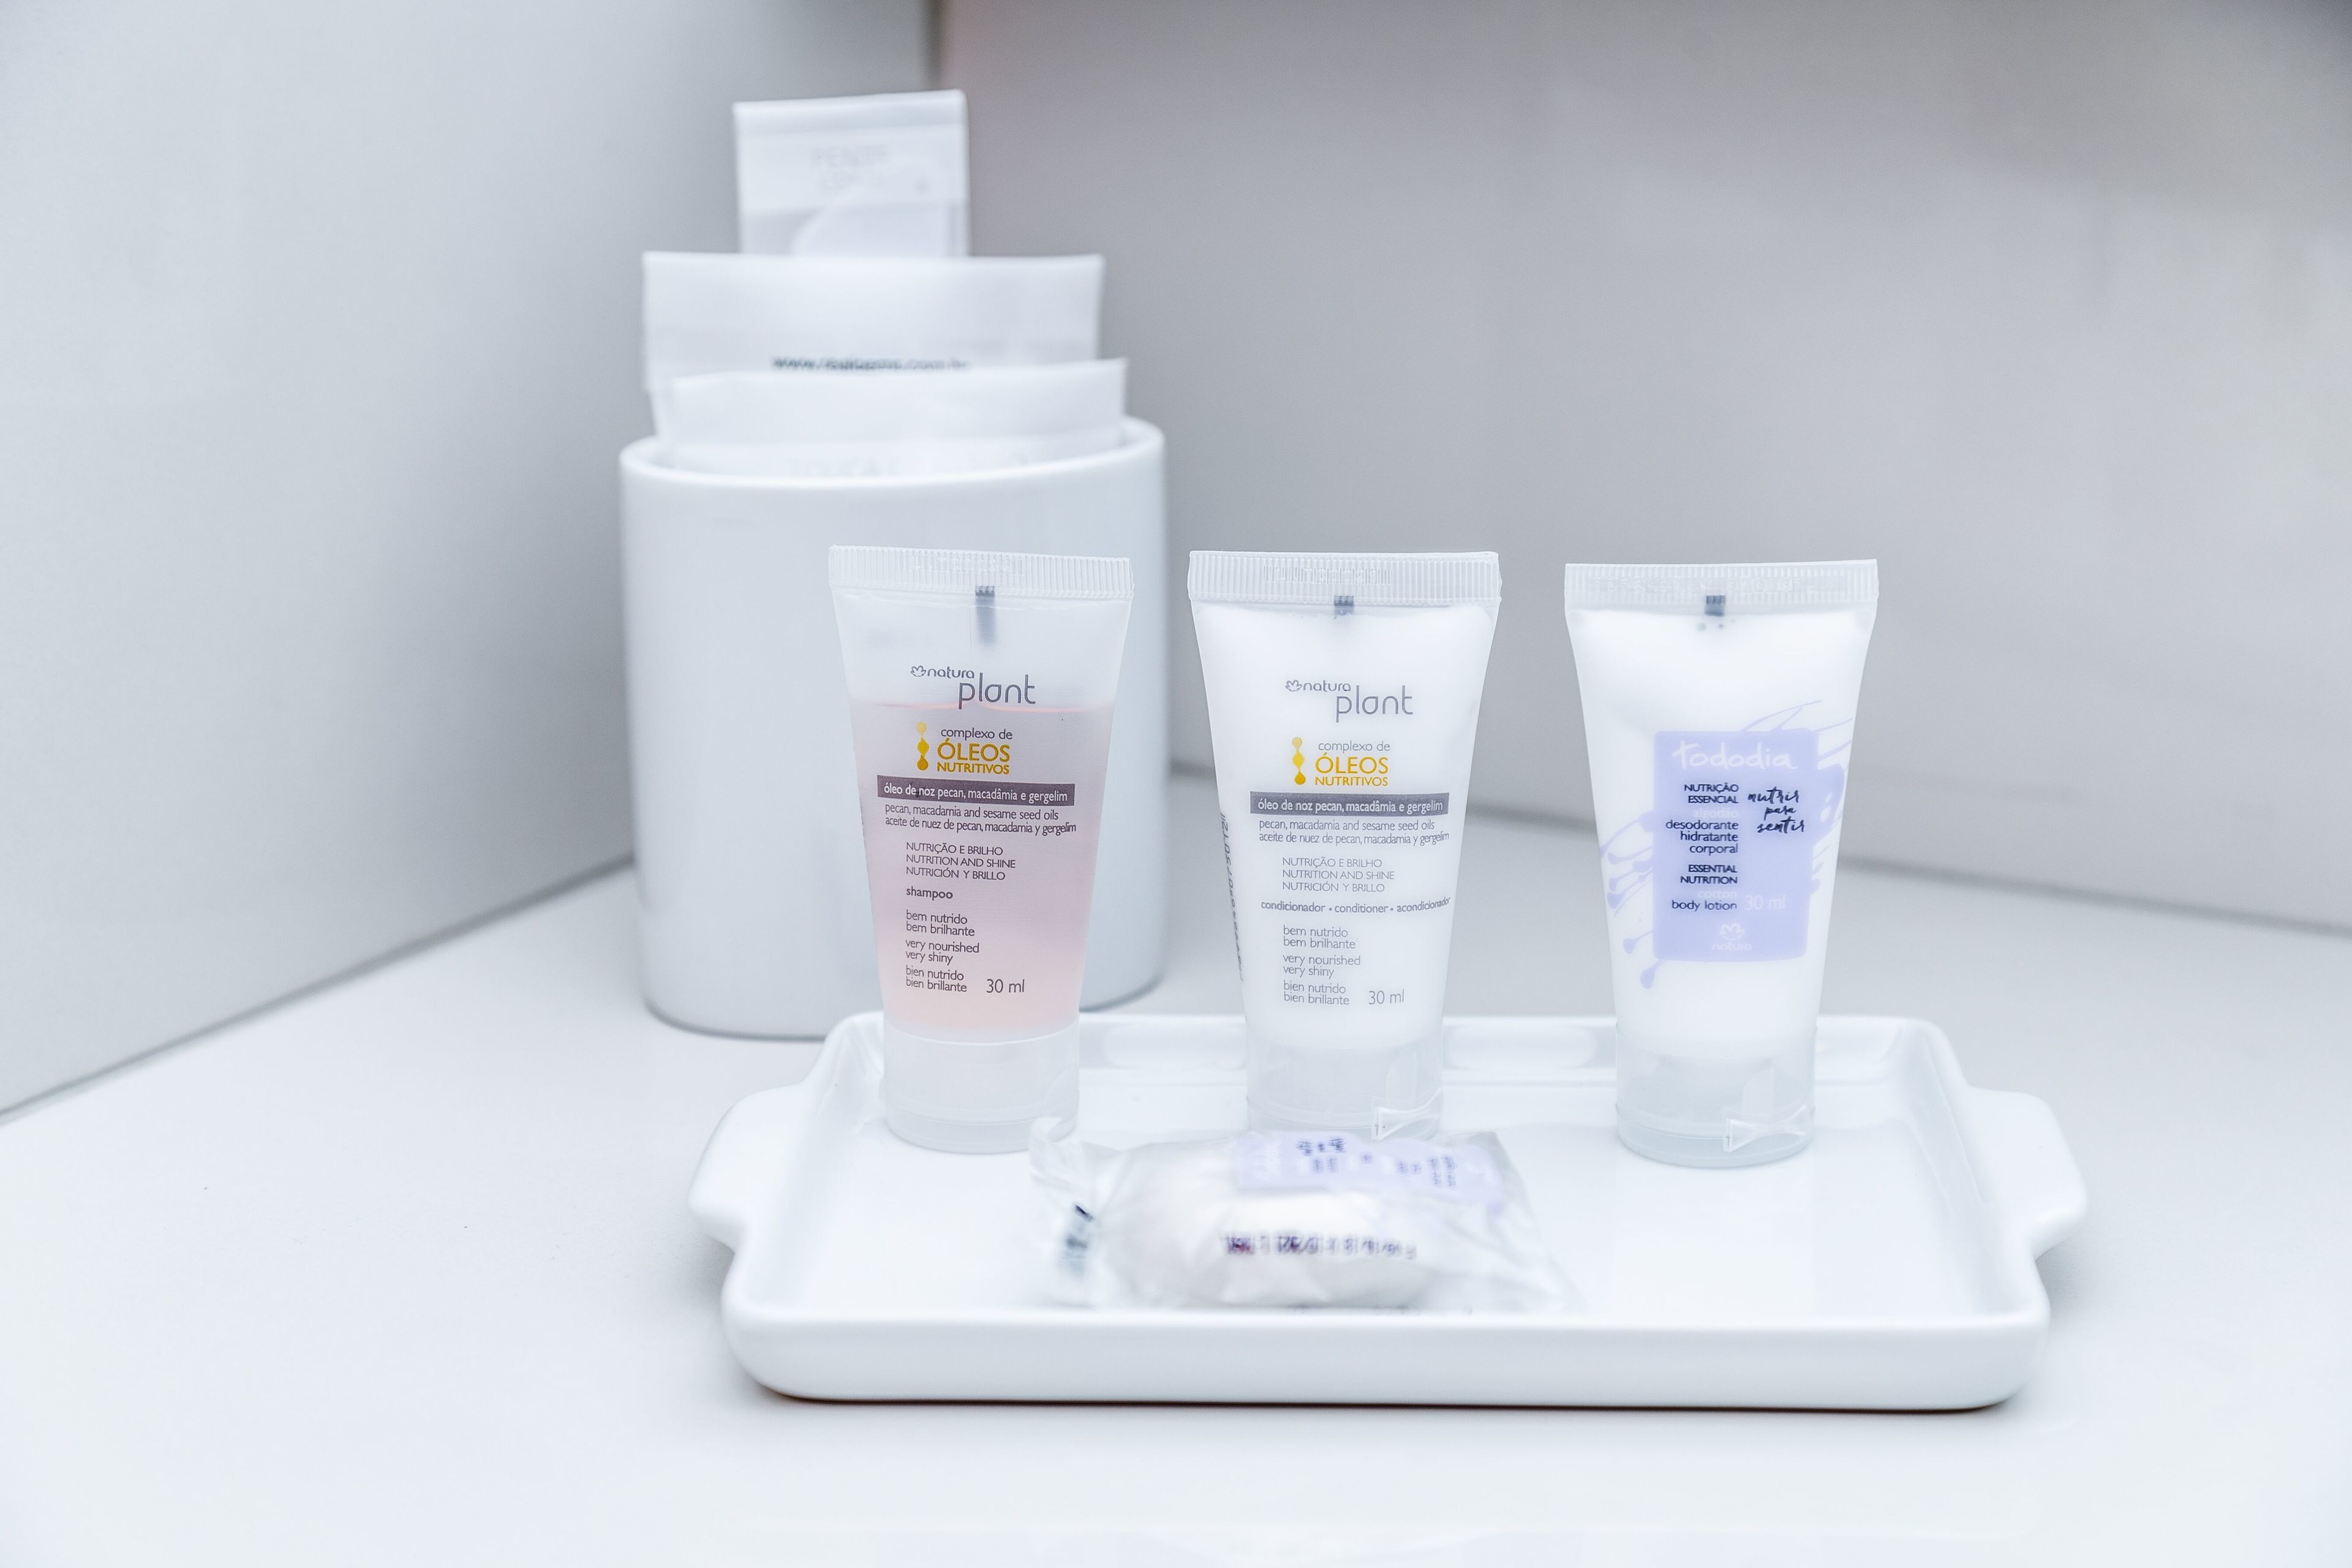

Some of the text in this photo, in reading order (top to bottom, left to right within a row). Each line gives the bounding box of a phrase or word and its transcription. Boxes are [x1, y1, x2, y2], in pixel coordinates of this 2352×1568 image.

[927, 666, 974, 679] natura
[959, 673, 1036, 709] plant
[1303, 680, 1351, 692] natura
[1336, 685, 1414, 723] plant
[941, 728, 1013, 741] complexo de
[937, 738, 1011, 763] ÓLEOS
[1318, 741, 1390, 753] complexo de
[937, 762, 1010, 775] NUTRITIVOS
[1315, 752, 1389, 774] ÓLEOS
[1315, 776, 1388, 786] NUTRITIVOS
[1684, 782, 1739, 794] NUTRIÇÃO
[884, 782, 1068, 804] óleo de noz pecan, macadâmia e gergelim
[1748, 786, 1800, 804] nutrir
[885, 804, 1058, 820] pecan, macadamia and sesame seed oils
[1258, 798, 1443, 815] óleo de noz pecan, macadâmia e gergelim
[1693, 807, 1738, 820] algodão
[1764, 805, 1796, 820] para
[885, 815, 1076, 836] aceite de nuez de pecan, macadamia y gergelim
[1259, 819, 1435, 831] pecan, macadamia and sesame seed oils
[1666, 820, 1739, 830] desodorante
[1756, 817, 1805, 834] sentir
[1259, 831, 1450, 846] aceite de nuez de pecan, macadamia y gergelim
[1680, 831, 1739, 842] hidratante
[907, 841, 1003, 856] NUTRIÇÃO E BRILHO
[1689, 843, 1738, 856] corporal
[907, 854, 1016, 869] NUTRITION AND SHINE
[1283, 856, 1382, 869] NUTRIÇÃO E BRILHO
[907, 867, 1006, 880] NUTRICIÓN Y BRILLO
[1283, 870, 1395, 880] NUTRITION AND SHINE
[906, 886, 953, 900] shampoo
[1283, 881, 1385, 892] NUTRICIÓN Y BRILLO
[1697, 889, 1738, 899] cotton
[1261, 896, 1451, 914] condicionador conditioner acondicionador
[1672, 900, 1737, 911] body lotion
[1744, 895, 1785, 910] 30 ml
[906, 909, 968, 924] bem nutrido
[906, 921, 975, 937] bem brilhante
[1283, 925, 1348, 938] bem nutrido
[905, 939, 979, 953] very nourished
[1283, 937, 1356, 949] bem brilhante
[1712, 941, 1752, 951] natura
[905, 951, 953, 965] very shiny
[1283, 954, 1361, 967] very nourished
[906, 965, 963, 981] bien nutrido
[1283, 966, 1335, 979] very shiny
[906, 976, 967, 992] bien brillante
[986, 979, 1025, 993] 30 ml
[1284, 980, 1346, 994] bien nutrido
[1284, 992, 1349, 1005] bien brillante
[1368, 989, 1404, 1005] 30 ml
